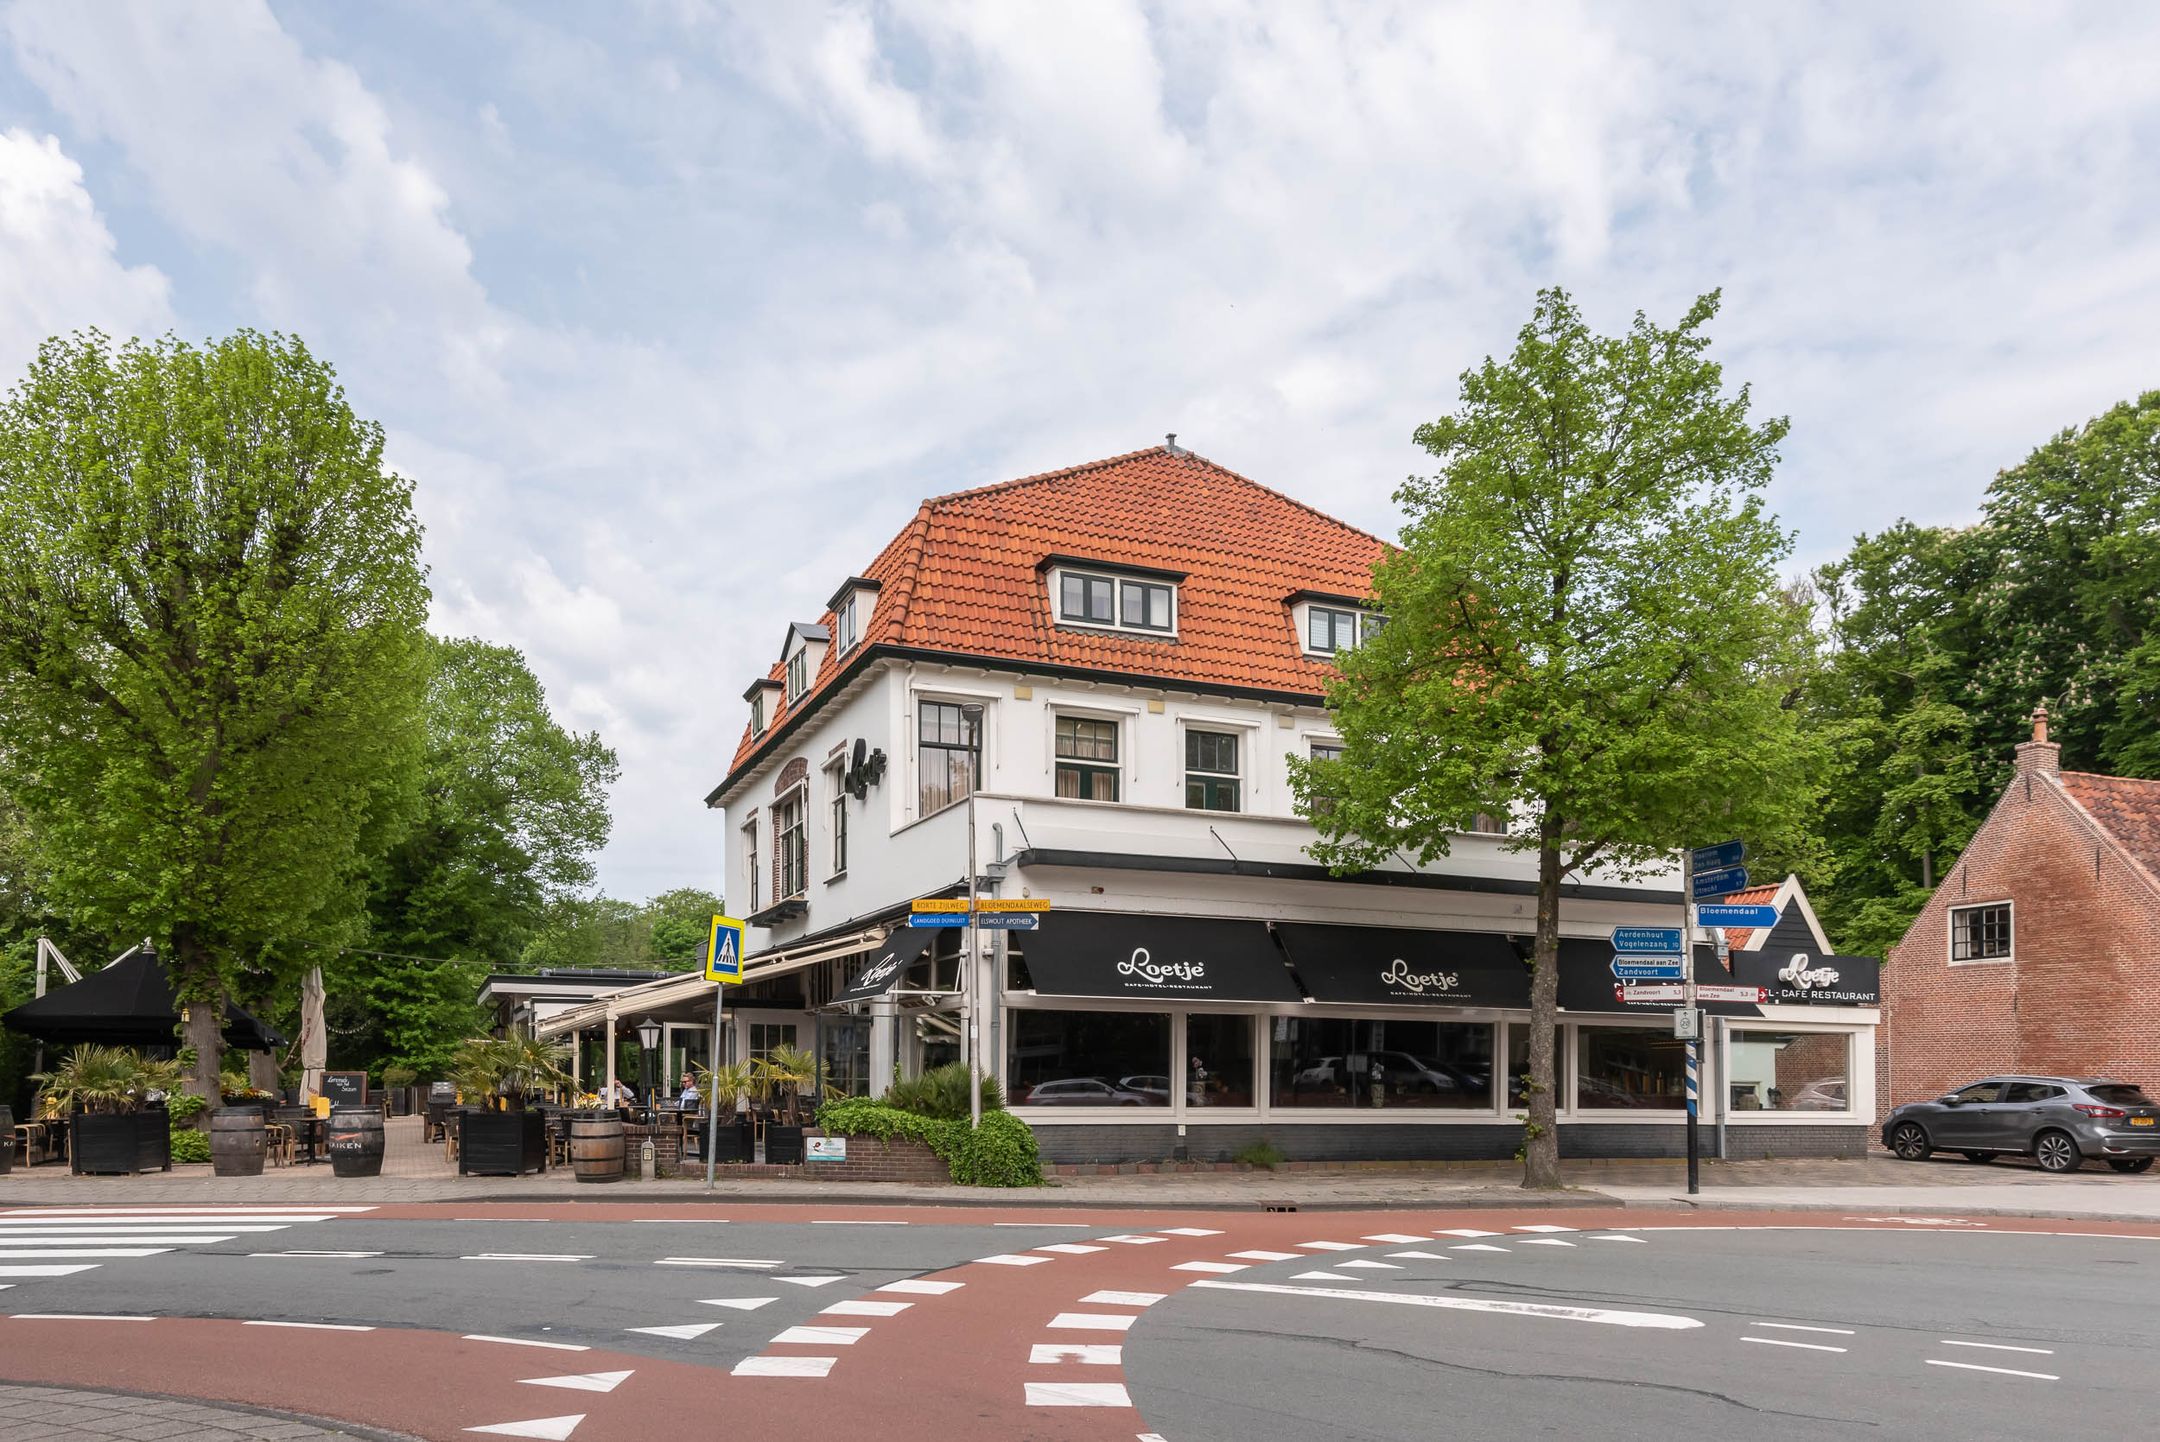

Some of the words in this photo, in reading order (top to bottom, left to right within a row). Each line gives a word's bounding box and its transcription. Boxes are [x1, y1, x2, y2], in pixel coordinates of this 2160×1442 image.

[1695, 873, 1730, 884] Amsterdam
[1695, 885, 1718, 895] Utrecht
[981, 901, 1048, 909] BLOEMENDAALSEWEG
[1700, 907, 1758, 915] Bloemendaal
[981, 916, 1004, 924] ELSWOUT
[1006, 917, 1032, 925] APOTHEEK
[1619, 941, 1668, 949] Vogelenzang
[1117, 947, 1205, 984] Loetje
[1381, 959, 1459, 993] Loetje
[1778, 953, 1840, 990] Loetje
[1811, 990, 1876, 1001] RESTAURANT
